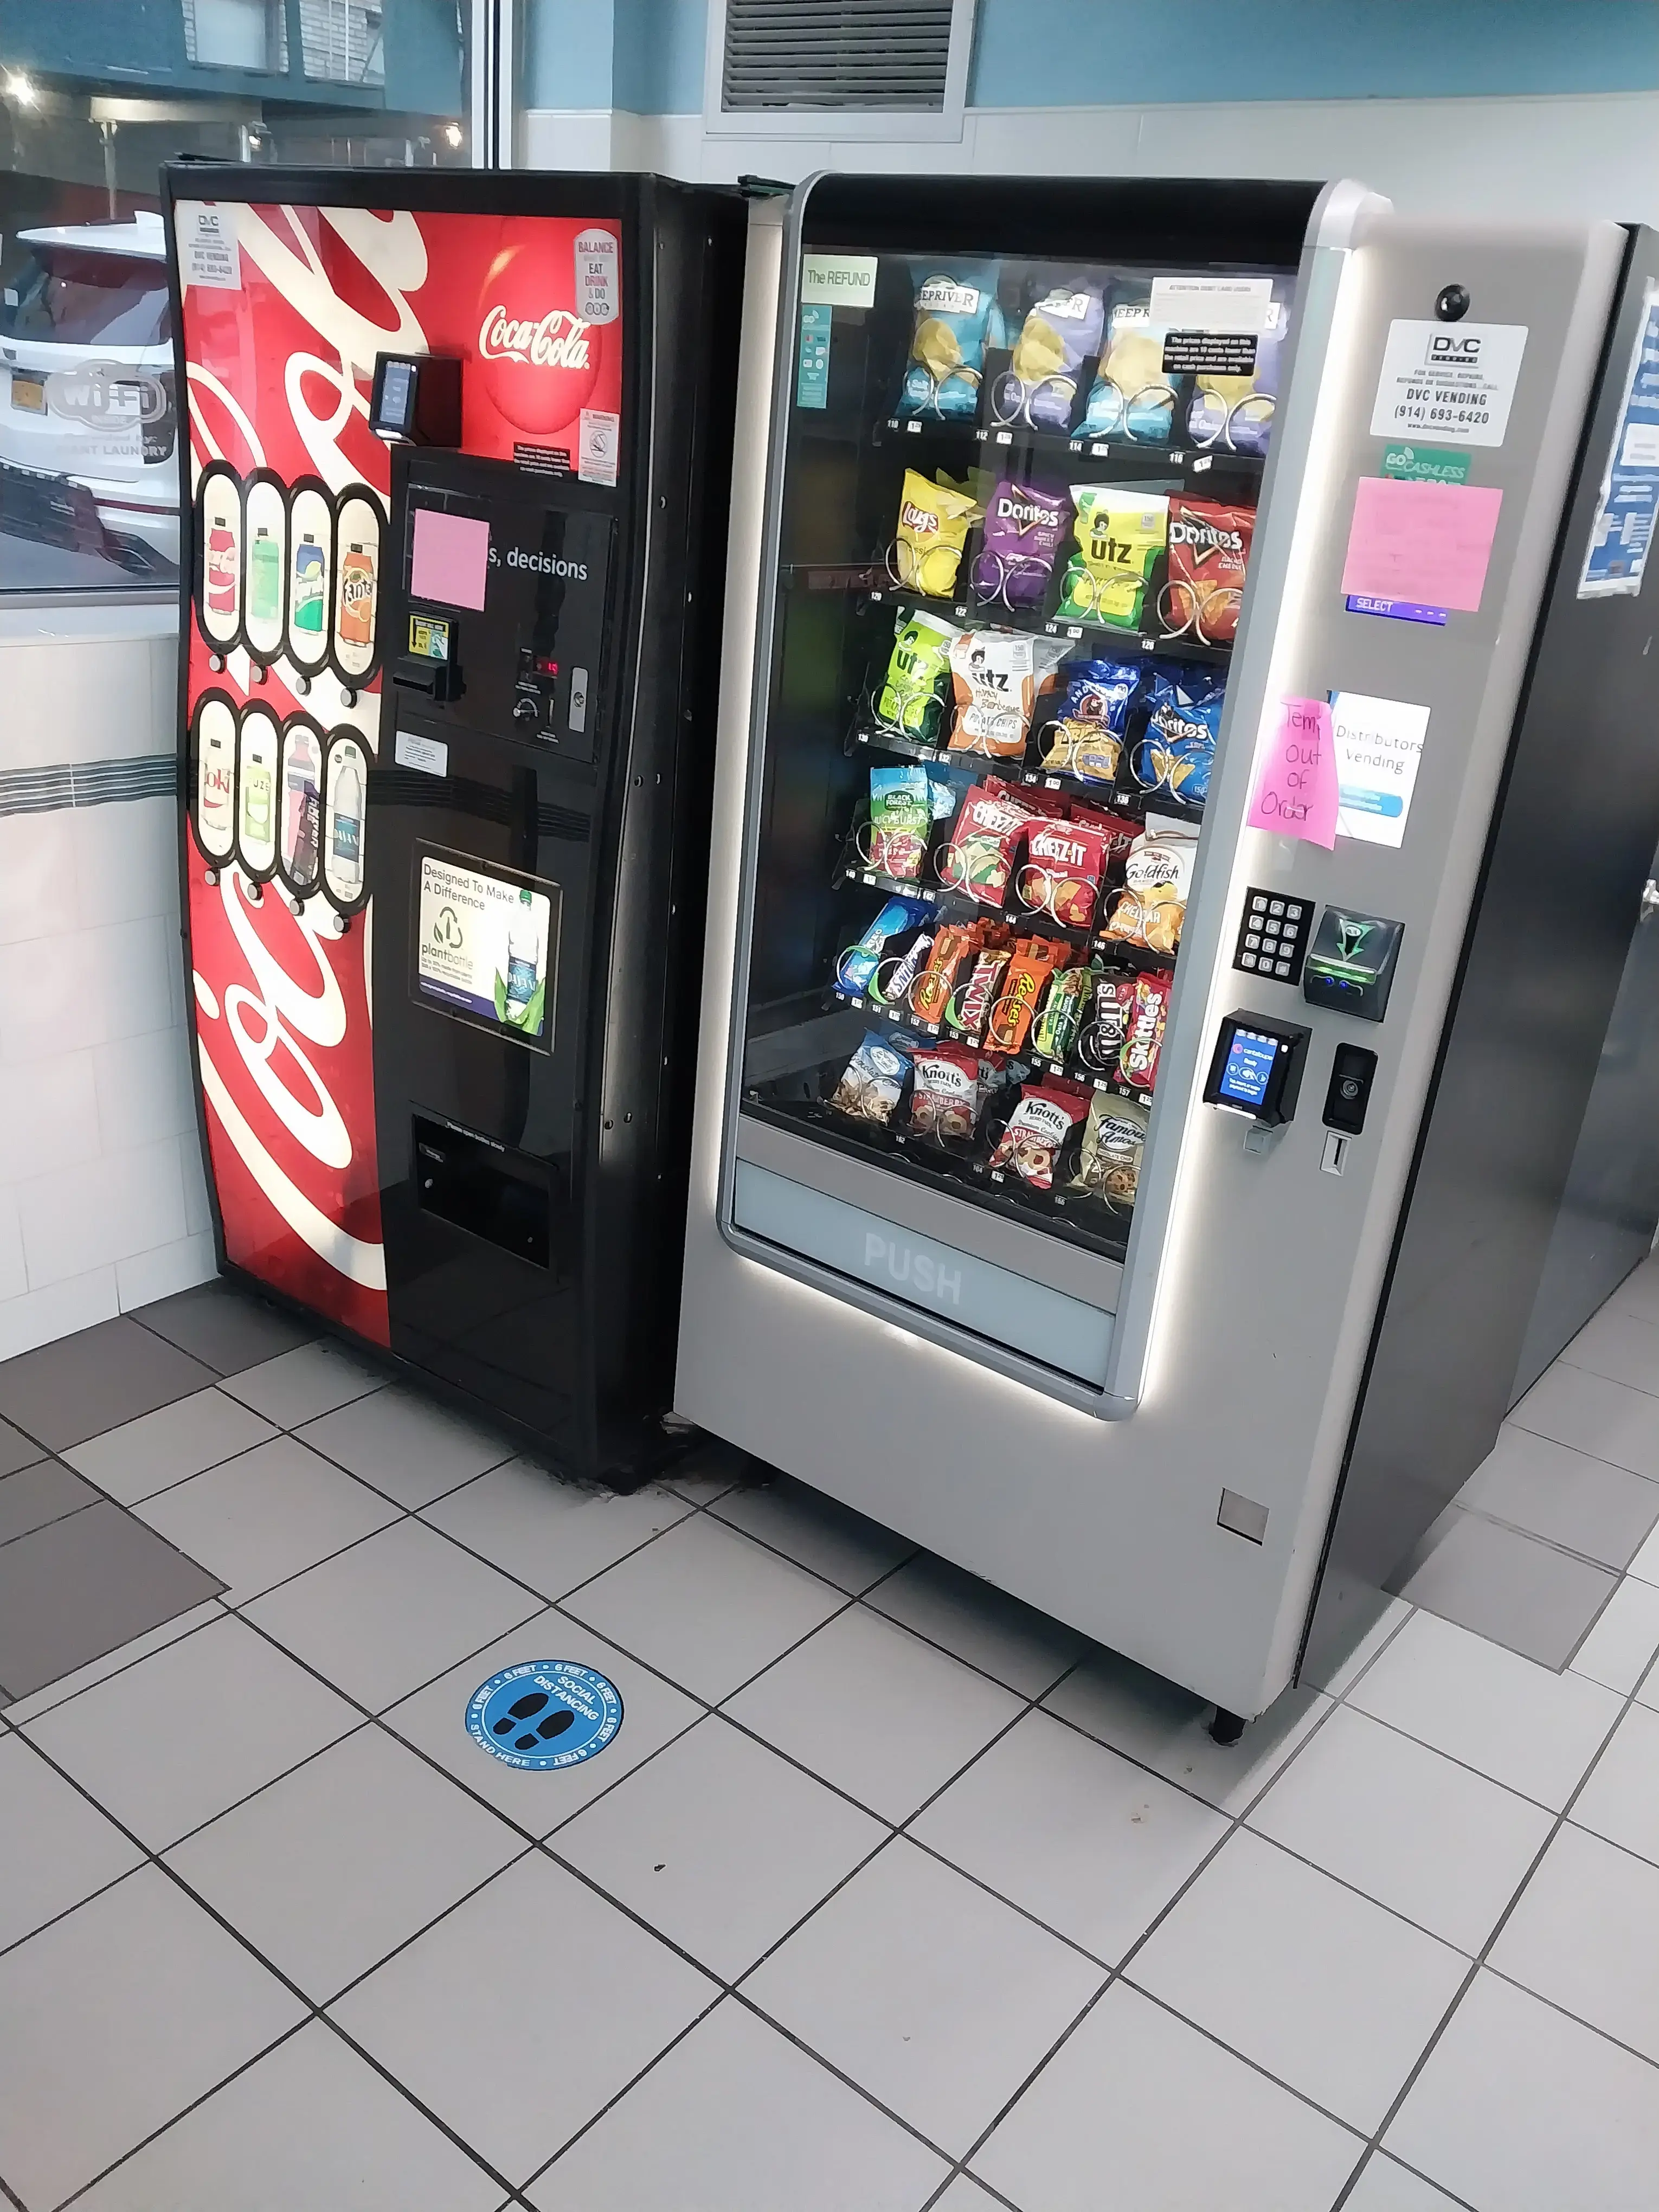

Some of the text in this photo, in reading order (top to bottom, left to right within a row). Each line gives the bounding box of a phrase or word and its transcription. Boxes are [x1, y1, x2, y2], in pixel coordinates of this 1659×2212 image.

[578, 241, 613, 253] BALANCE
[589, 263, 603, 274] EAT
[585, 275, 608, 286] DRINK
[808, 270, 870, 286] The REFUND
[479, 305, 590, 370] Coca-Cola
[1433, 337, 1481, 353] DVC
[1406, 388, 1487, 406] DVC VENDING
[1394, 404, 1489, 424] (914) 693-6420
[976, 432, 988, 441] 112
[102, 446, 168, 456] LAUNDRY
[1070, 442, 1082, 452] 114
[1386, 453, 1465, 478] GO CASHLESS
[998, 498, 1059, 526] Doritos
[1170, 522, 1242, 549] Doritos
[507, 546, 588, 580] decisions
[955, 607, 966, 617] 122
[1356, 597, 1393, 613] SELECT
[1045, 624, 1057, 633] 124
[996, 718, 1018, 729] CHIPS
[1336, 725, 1425, 754] Distributors
[1285, 744, 1322, 766] Out
[1025, 774, 1036, 783] 134
[1126, 863, 1180, 880] Goldfish
[423, 863, 515, 904] Designed To Make
[423, 880, 485, 910] A Difference
[1006, 915, 1016, 924] 144
[1094, 940, 1105, 949] 146
[422, 943, 473, 970] plantbottle
[962, 962, 999, 1030] TWIX
[1008, 973, 1036, 1026] Reese's
[872, 1004, 882, 1013] 151
[910, 1017, 919, 1026] 152
[949, 1031, 959, 1039] 153
[1129, 991, 1163, 1071] Skittles
[1031, 1057, 1041, 1066] 155
[922, 1064, 962, 1088] Knott's
[1075, 1073, 1085, 1082] 156
[1118, 1087, 1130, 1096] 157
[1024, 1101, 1065, 1130] Knott's
[864, 1232, 961, 1304] PUSH
[512, 1664, 537, 1678] FEET
[564, 1665, 588, 1677] FEET
[533, 1675, 600, 1721] DISTANCING
[557, 1676, 596, 1705] SOCIAL
[600, 1686, 617, 1705] FEET
[597, 1723, 615, 1743] FEET
[471, 1724, 531, 1767] STAND HERE
[553, 1752, 580, 1766] FEET
